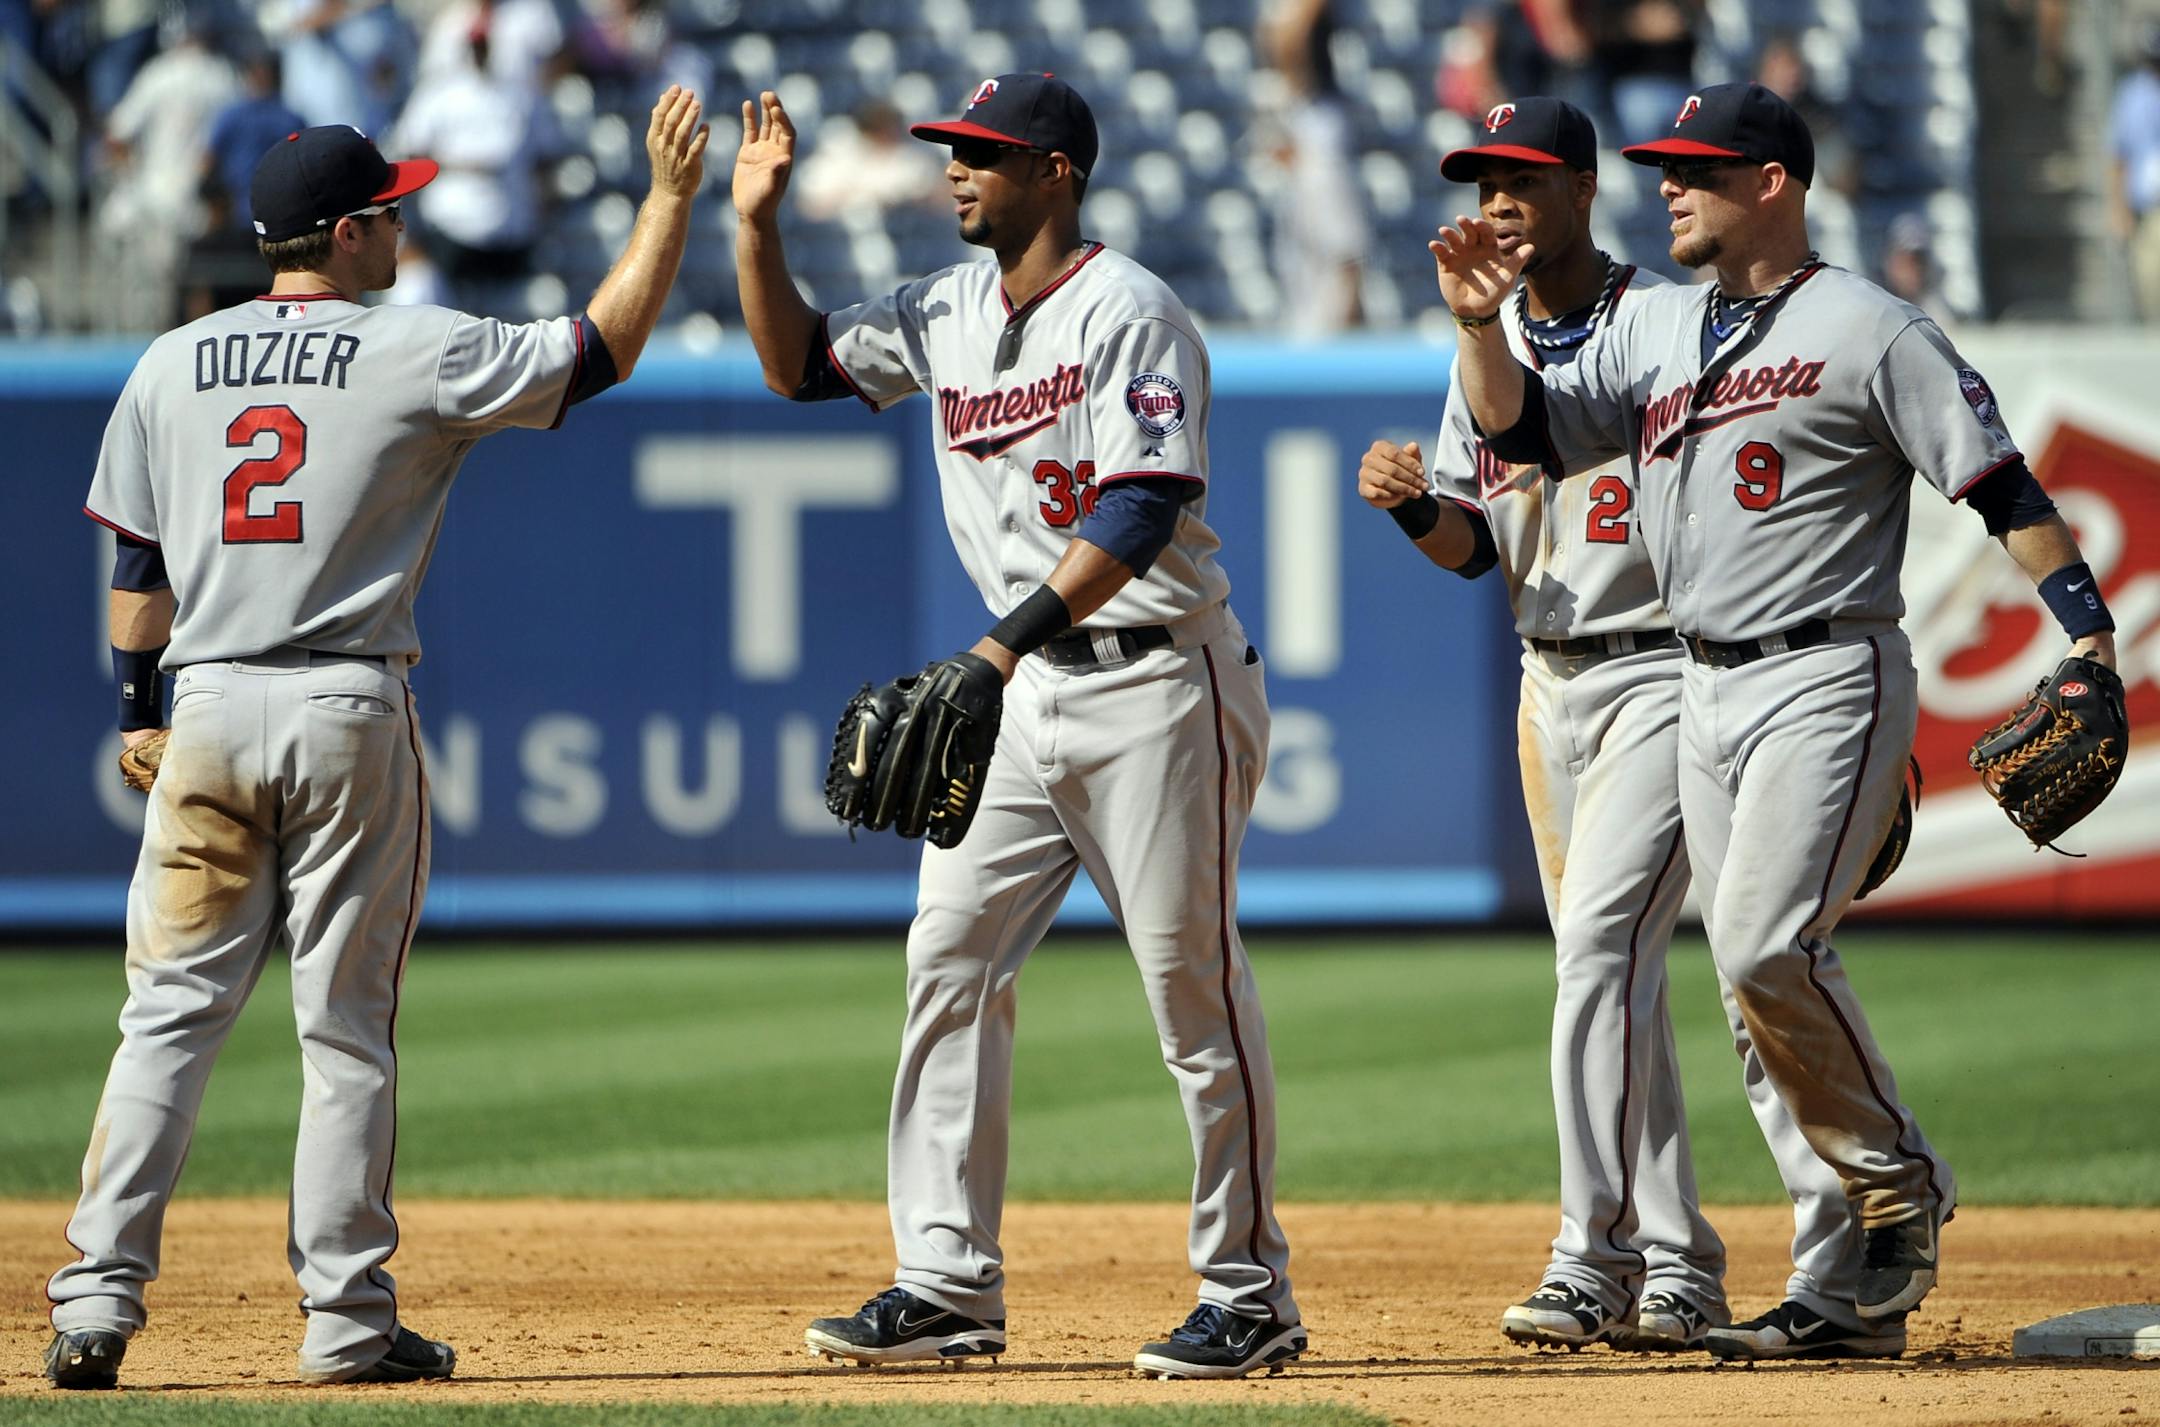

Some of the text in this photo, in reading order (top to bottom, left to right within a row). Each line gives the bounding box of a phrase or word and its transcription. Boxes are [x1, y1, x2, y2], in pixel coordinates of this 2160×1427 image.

[196, 332, 361, 392] DOZIER
[1128, 391, 1183, 417] Twins
[1131, 375, 1180, 394] MINNESOTA
[222, 404, 307, 544] 2
[1734, 440, 1783, 513] 9
[2084, 592, 2098, 610] 9
